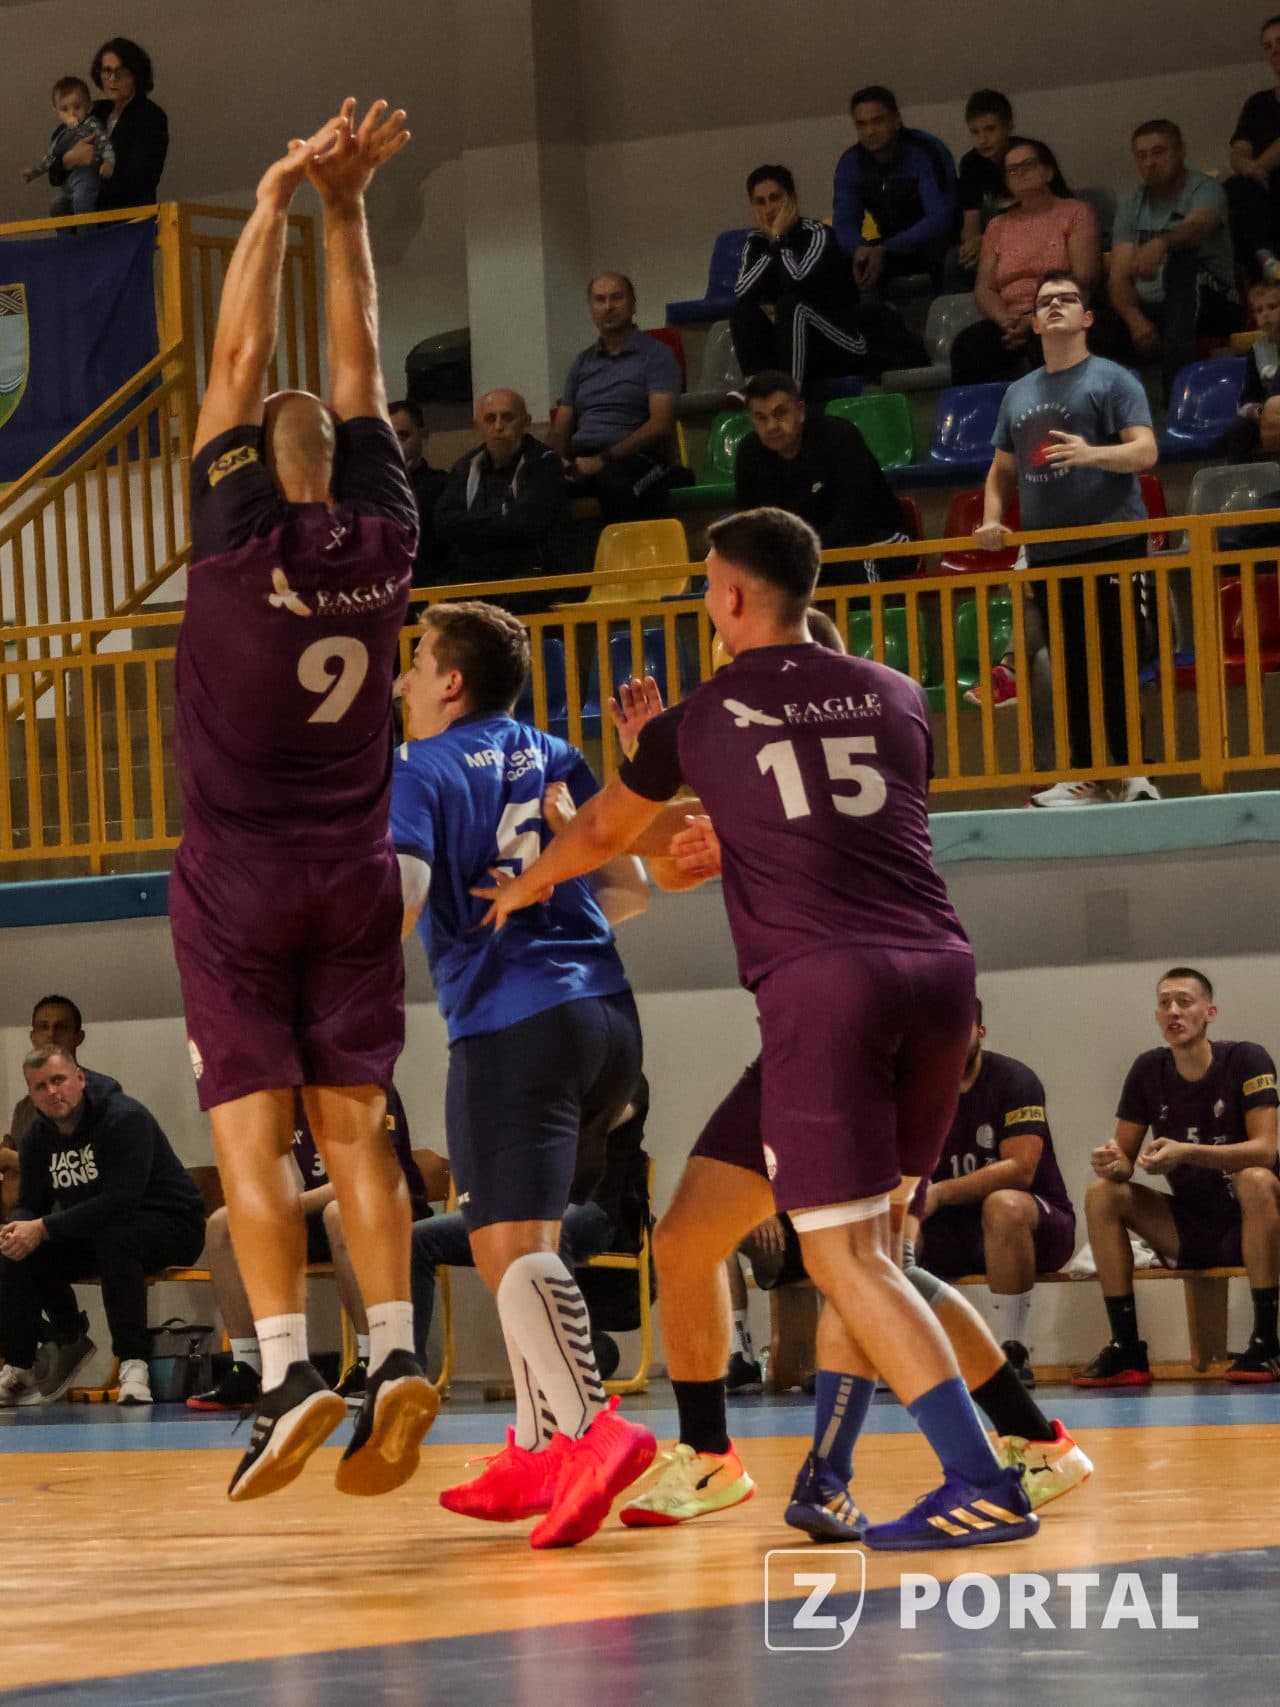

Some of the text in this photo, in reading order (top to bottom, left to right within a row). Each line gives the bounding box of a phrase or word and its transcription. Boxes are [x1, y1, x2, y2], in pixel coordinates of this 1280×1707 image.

[297, 636, 369, 723] 9
[784, 693, 881, 718] EAGLE
[755, 735, 887, 820] 15
[950, 1153, 976, 1178] 10
